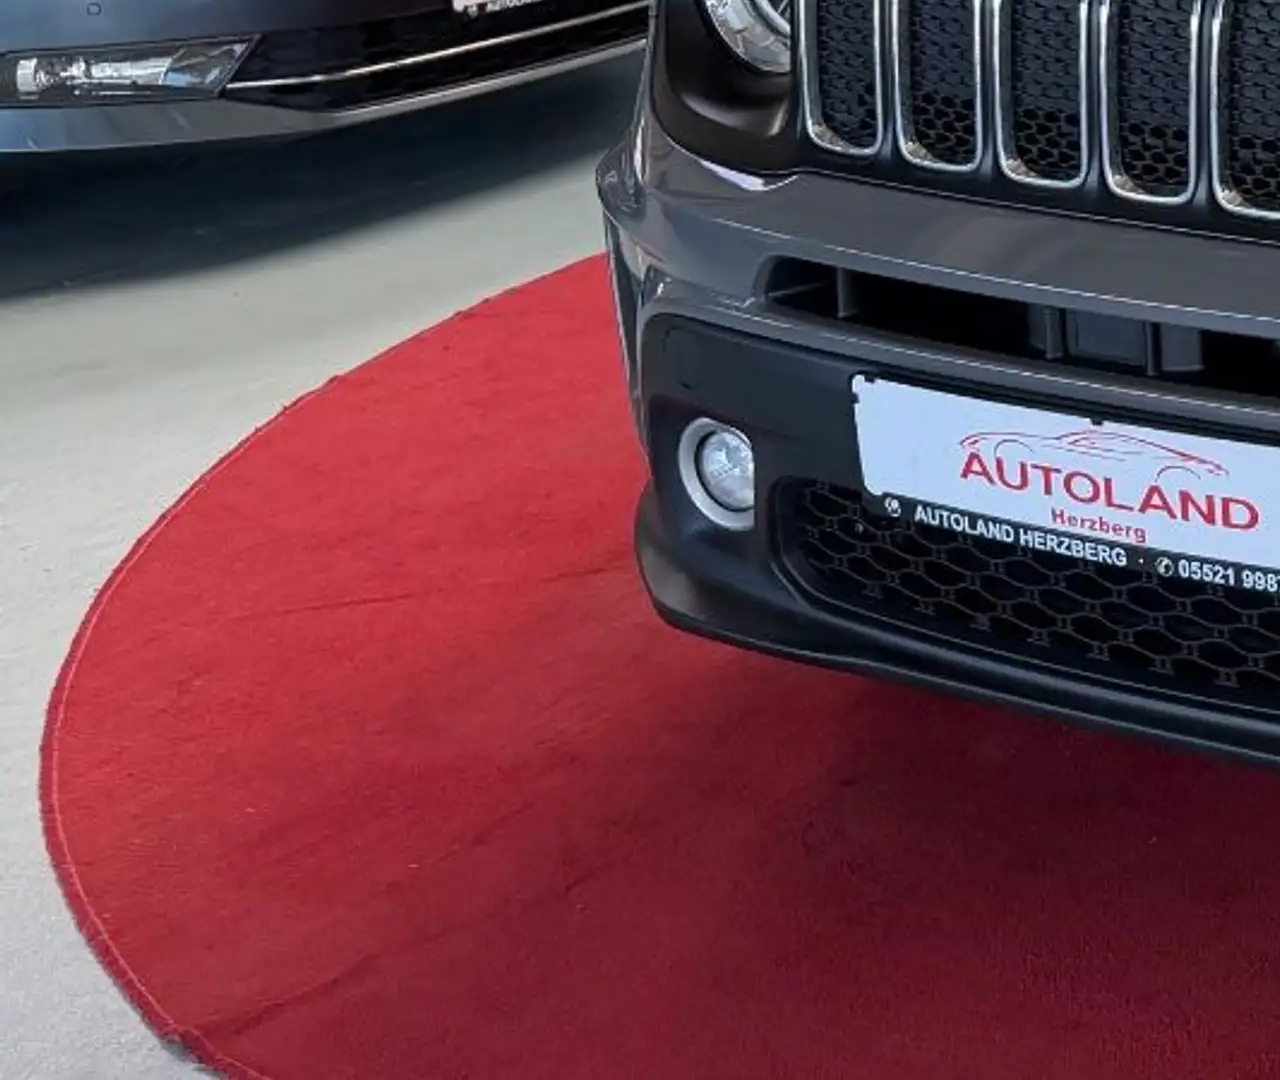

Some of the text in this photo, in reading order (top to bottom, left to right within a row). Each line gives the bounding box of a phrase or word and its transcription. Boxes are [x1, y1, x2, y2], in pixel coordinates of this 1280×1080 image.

[960, 451, 1260, 530] AUTOLAND
[1051, 507, 1146, 543] Herzberg
[914, 504, 1015, 543] AUTOLAND
[1019, 528, 1127, 567] HERZBERG
[1177, 558, 1236, 586] 05521
